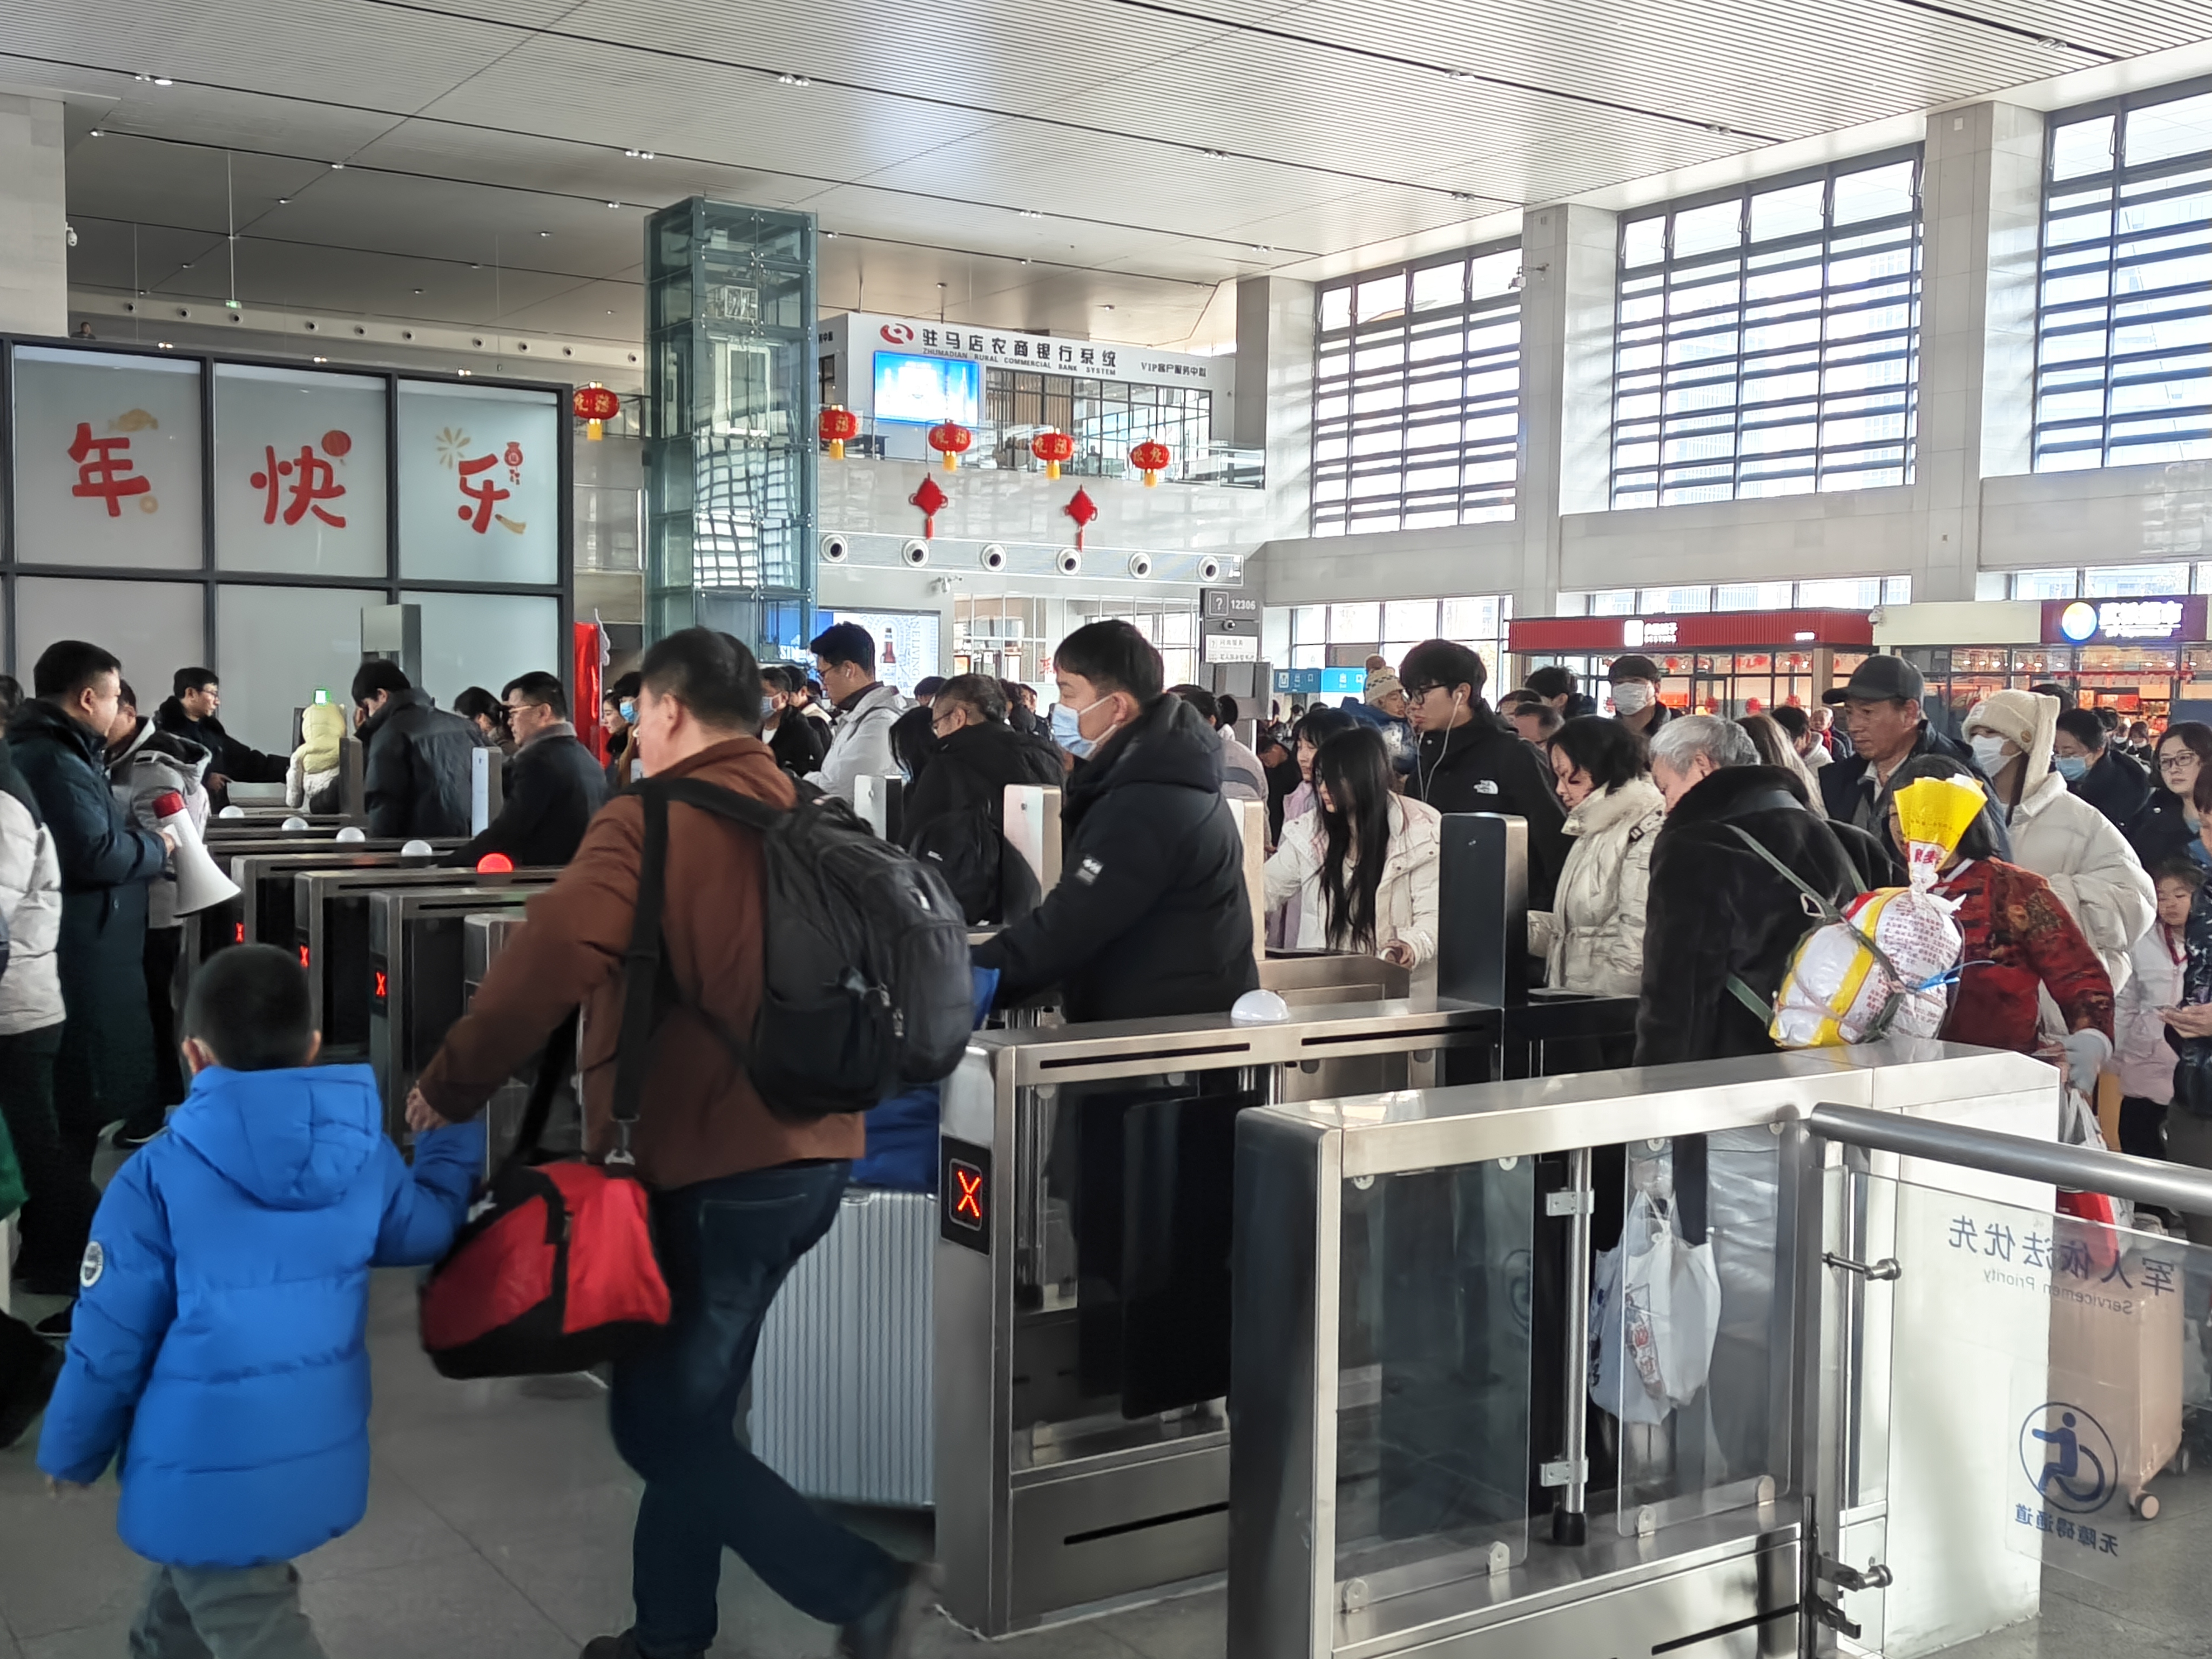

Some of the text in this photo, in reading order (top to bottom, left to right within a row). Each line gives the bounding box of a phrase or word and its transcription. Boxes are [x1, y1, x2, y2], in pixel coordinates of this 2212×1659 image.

[923, 329, 1116, 367] 驻马店农商银行系统
[923, 348, 1116, 376] ZHUMADIAN RURAL COMMERCIAL BANK SYSTEM
[1231, 599, 1256, 610] 12306
